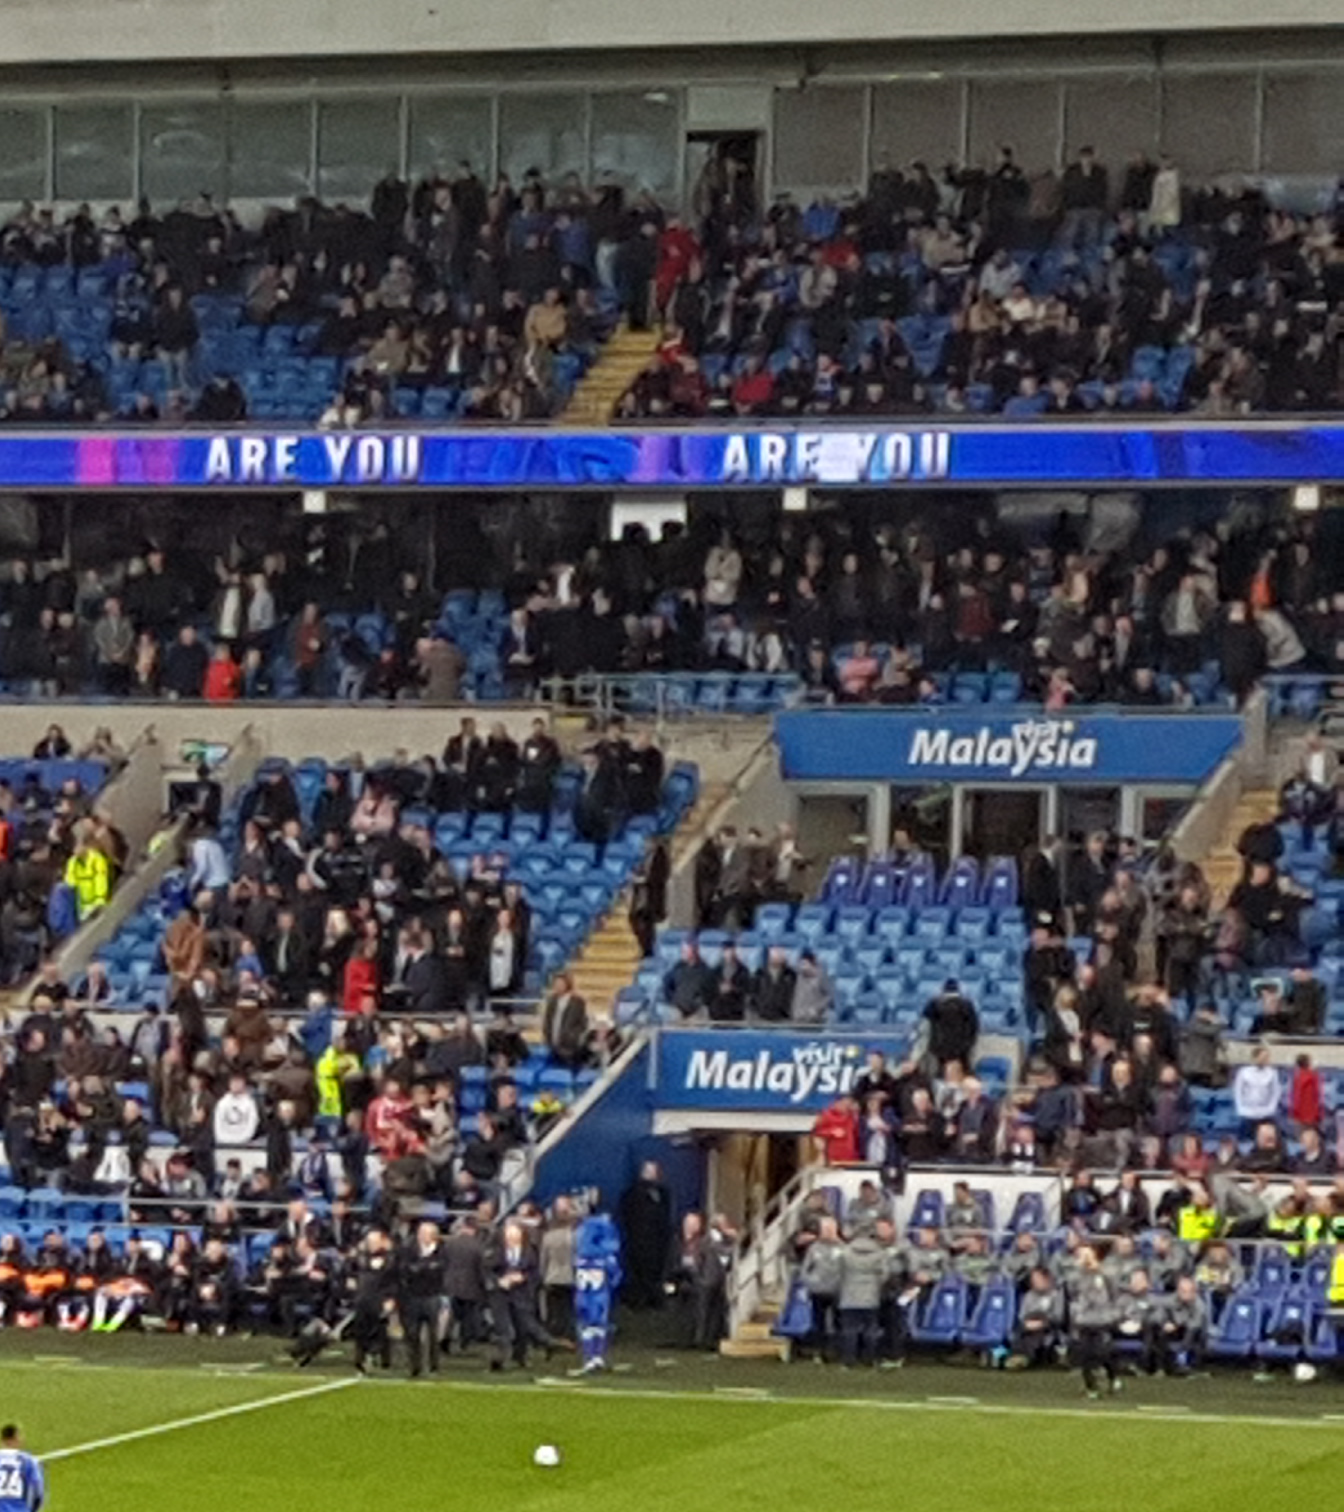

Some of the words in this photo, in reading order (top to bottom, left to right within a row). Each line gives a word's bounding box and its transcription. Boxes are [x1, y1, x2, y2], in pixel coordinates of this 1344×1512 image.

[206, 437, 298, 480] ARE
[324, 436, 419, 480] YOU
[723, 434, 820, 480] ARE
[853, 432, 950, 480] YOU
[908, 727, 1098, 777] Malaysia
